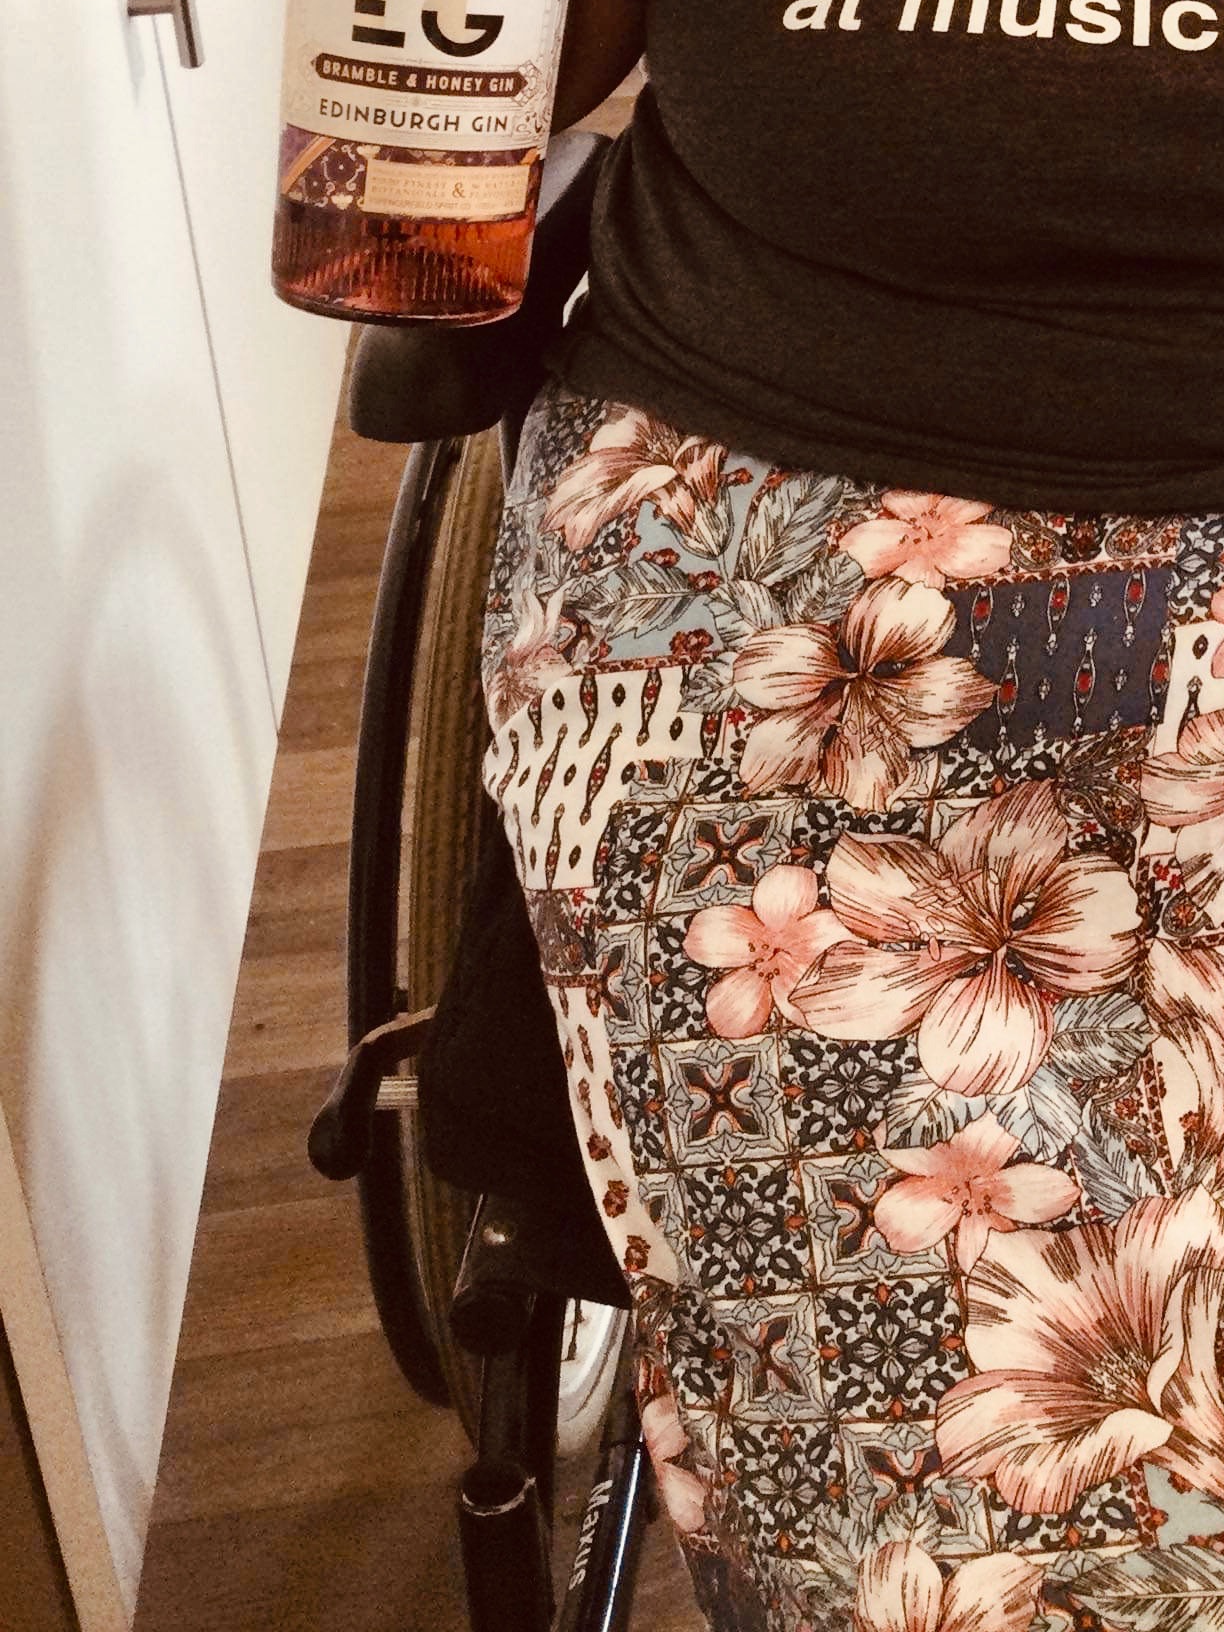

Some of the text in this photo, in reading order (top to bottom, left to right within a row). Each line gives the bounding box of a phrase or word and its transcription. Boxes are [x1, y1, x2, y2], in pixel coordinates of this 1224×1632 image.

[322, 59, 514, 92] BRAMBLE & HONEY GIN
[319, 98, 508, 133] EDINBURGH GIN
[452, 182, 466, 199] &
[568, 1479, 613, 1591] Maxus
